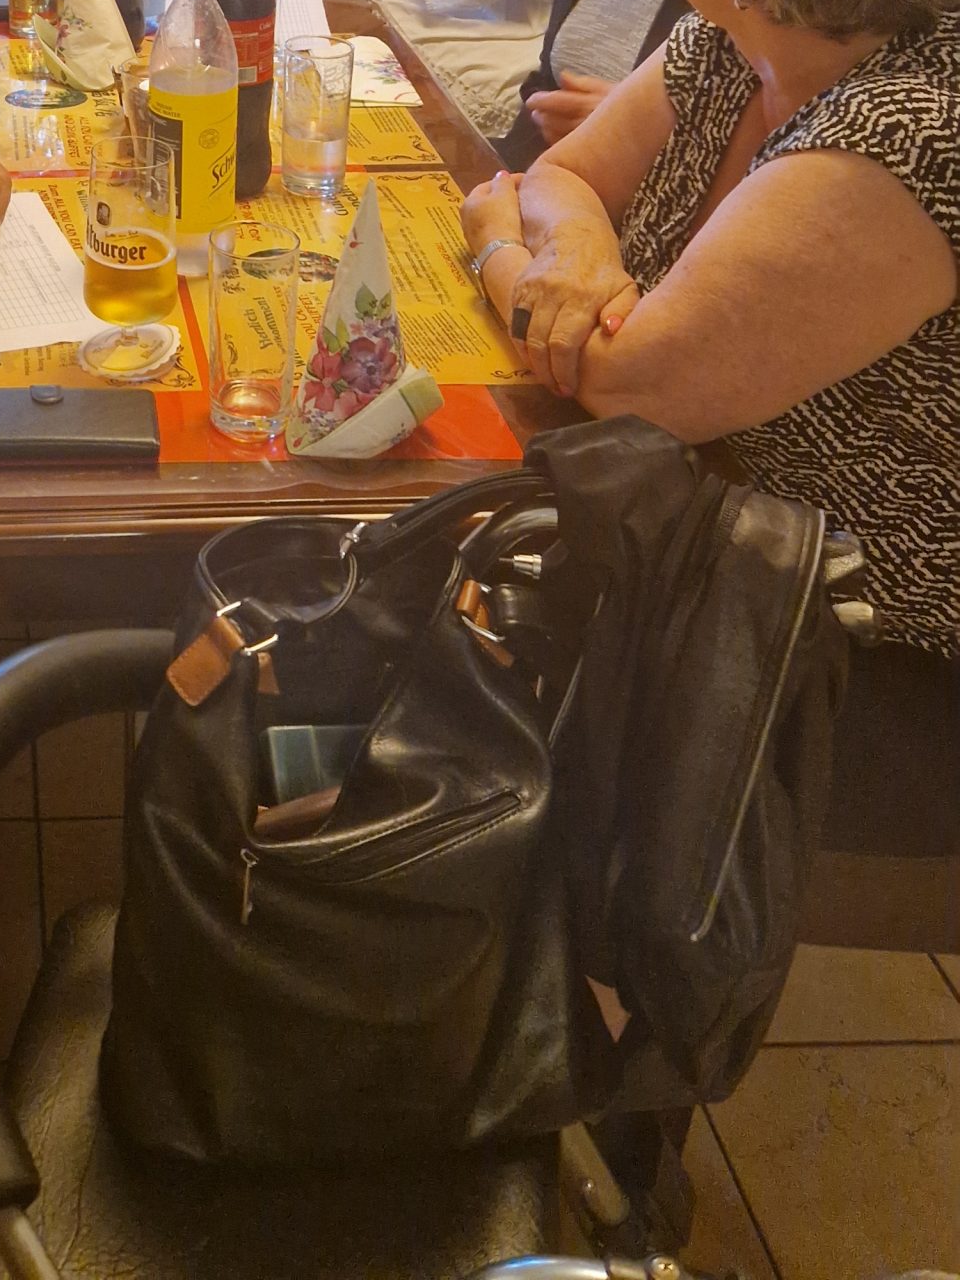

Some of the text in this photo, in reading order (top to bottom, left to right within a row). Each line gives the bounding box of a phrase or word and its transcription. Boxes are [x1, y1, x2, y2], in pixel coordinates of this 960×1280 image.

[54, 198, 64, 208] ALL
[58, 210, 69, 223] YOU
[64, 223, 76, 237] CAN
[70, 237, 83, 250] EAT
